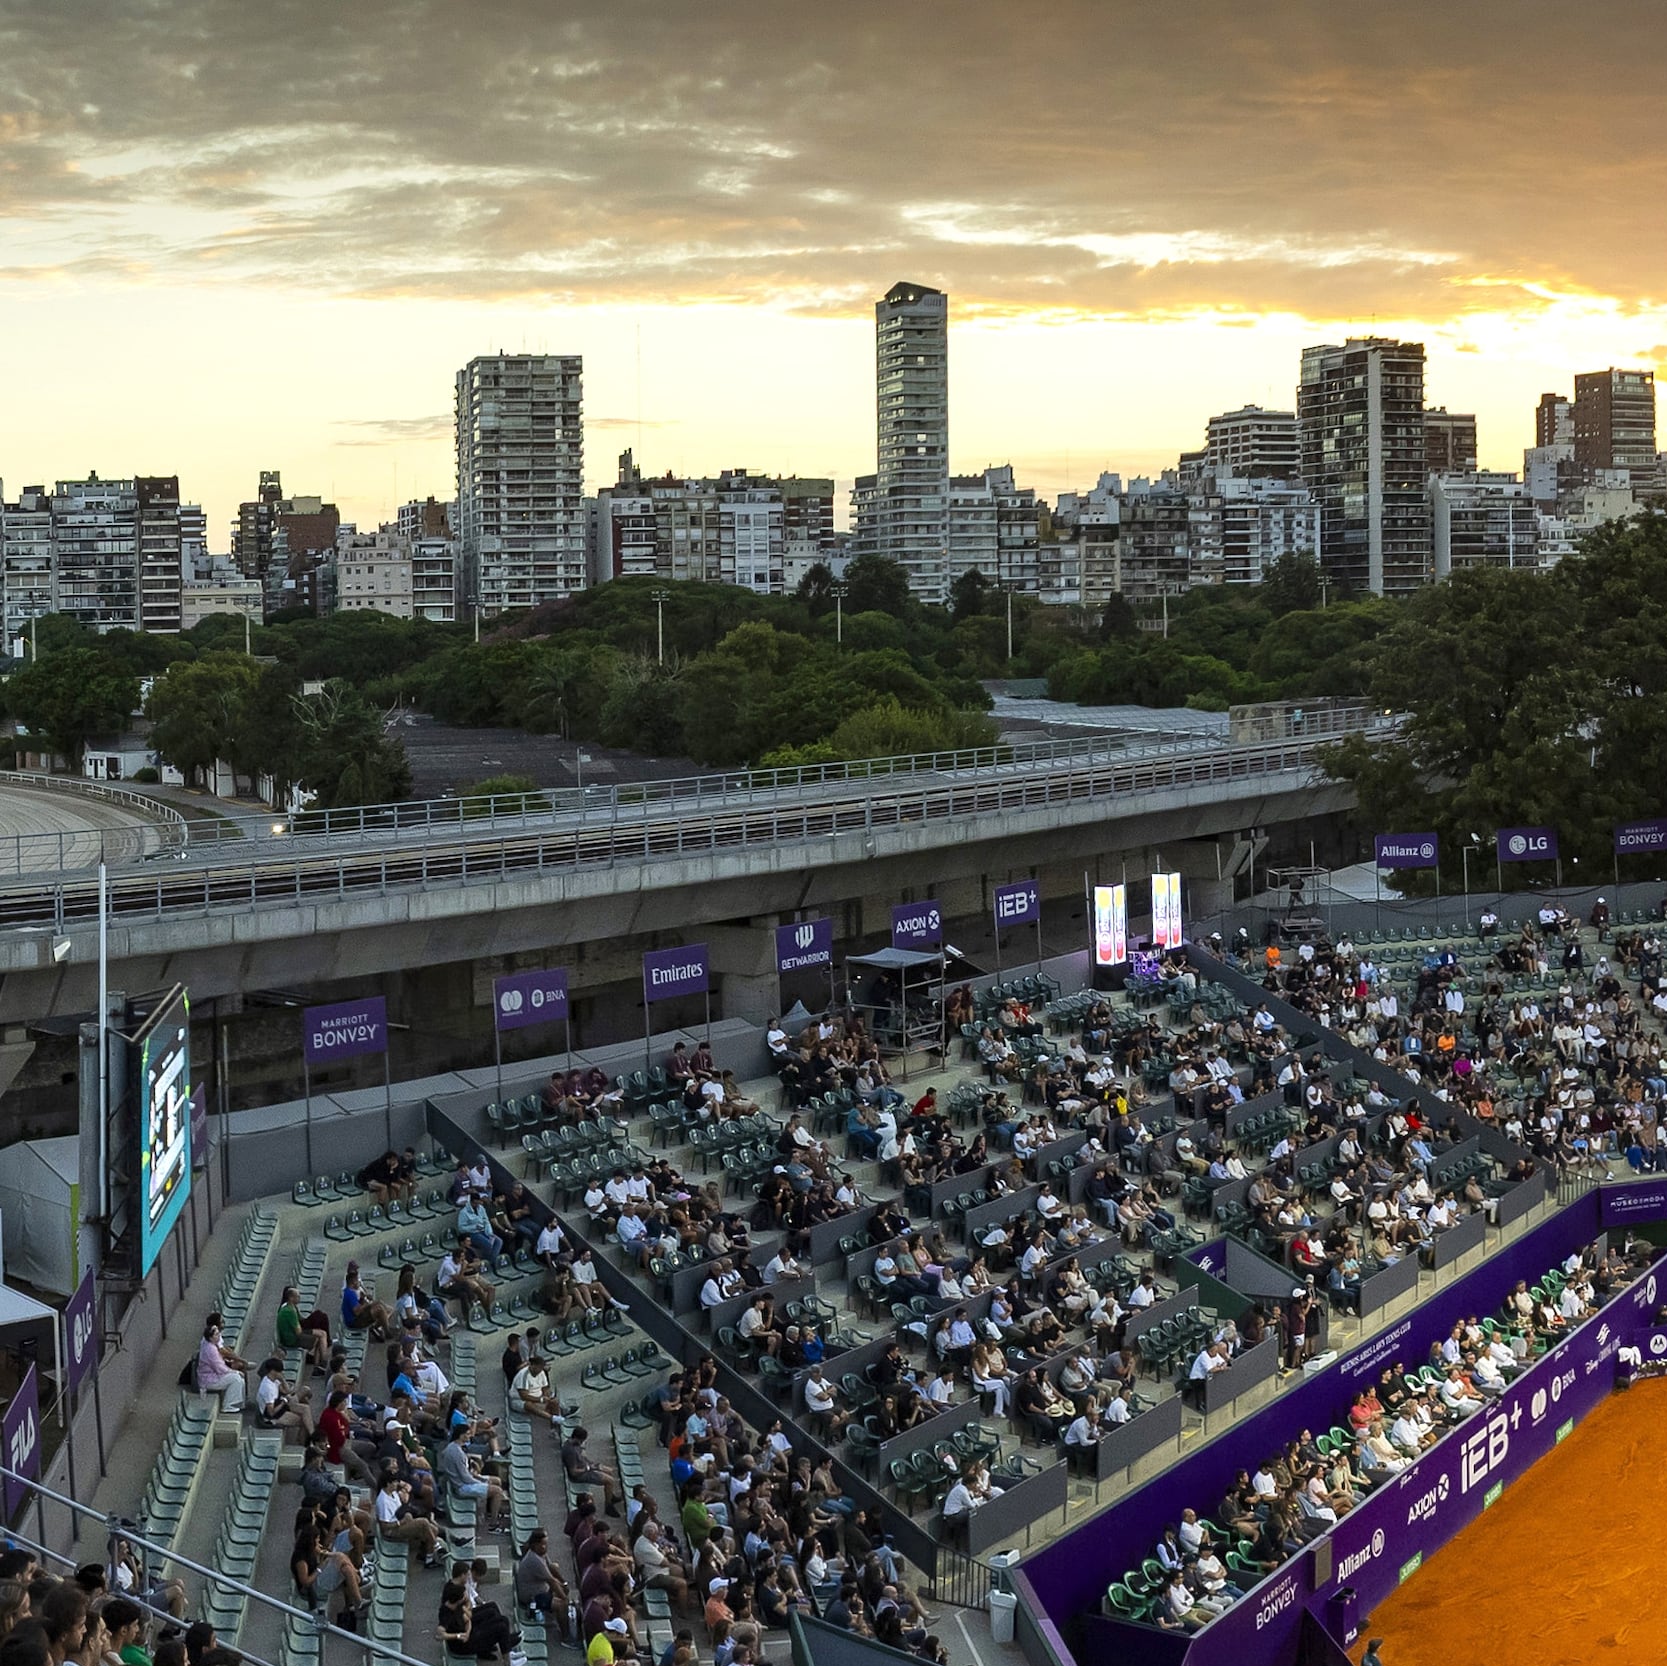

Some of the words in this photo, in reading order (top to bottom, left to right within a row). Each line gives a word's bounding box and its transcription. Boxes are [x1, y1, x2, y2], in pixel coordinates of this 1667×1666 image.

[1381, 845, 1418, 857] Allianz
[1529, 836, 1548, 850] LG
[1619, 832, 1665, 846] BONVOY
[896, 916, 927, 934] AXION
[781, 950, 830, 971] BETWARRIOR
[651, 962, 704, 986] Emirates
[545, 989, 566, 1003] BNA
[320, 1013, 369, 1029] MARRIOTT
[313, 1024, 374, 1049] BONVOY
[82, 1301, 93, 1344] LG
[1340, 1354, 1360, 1375] BUENOS
[1360, 1348, 1373, 1362] AIRES
[1373, 1339, 1385, 1353] LAWN
[1385, 1330, 1400, 1344] TENNIS
[1400, 1320, 1411, 1335] CLUB
[1562, 1368, 1576, 1390] BNA
[11, 1406, 35, 1474] FILA
[1407, 1487, 1437, 1525] AXION
[1337, 1545, 1372, 1584] Allianz
[1401, 1556, 1421, 1580] JUMBO
[1261, 1575, 1292, 1607] MARRIOTT
[1256, 1582, 1298, 1631] BONVOY
[1345, 1628, 1357, 1644] FILA
